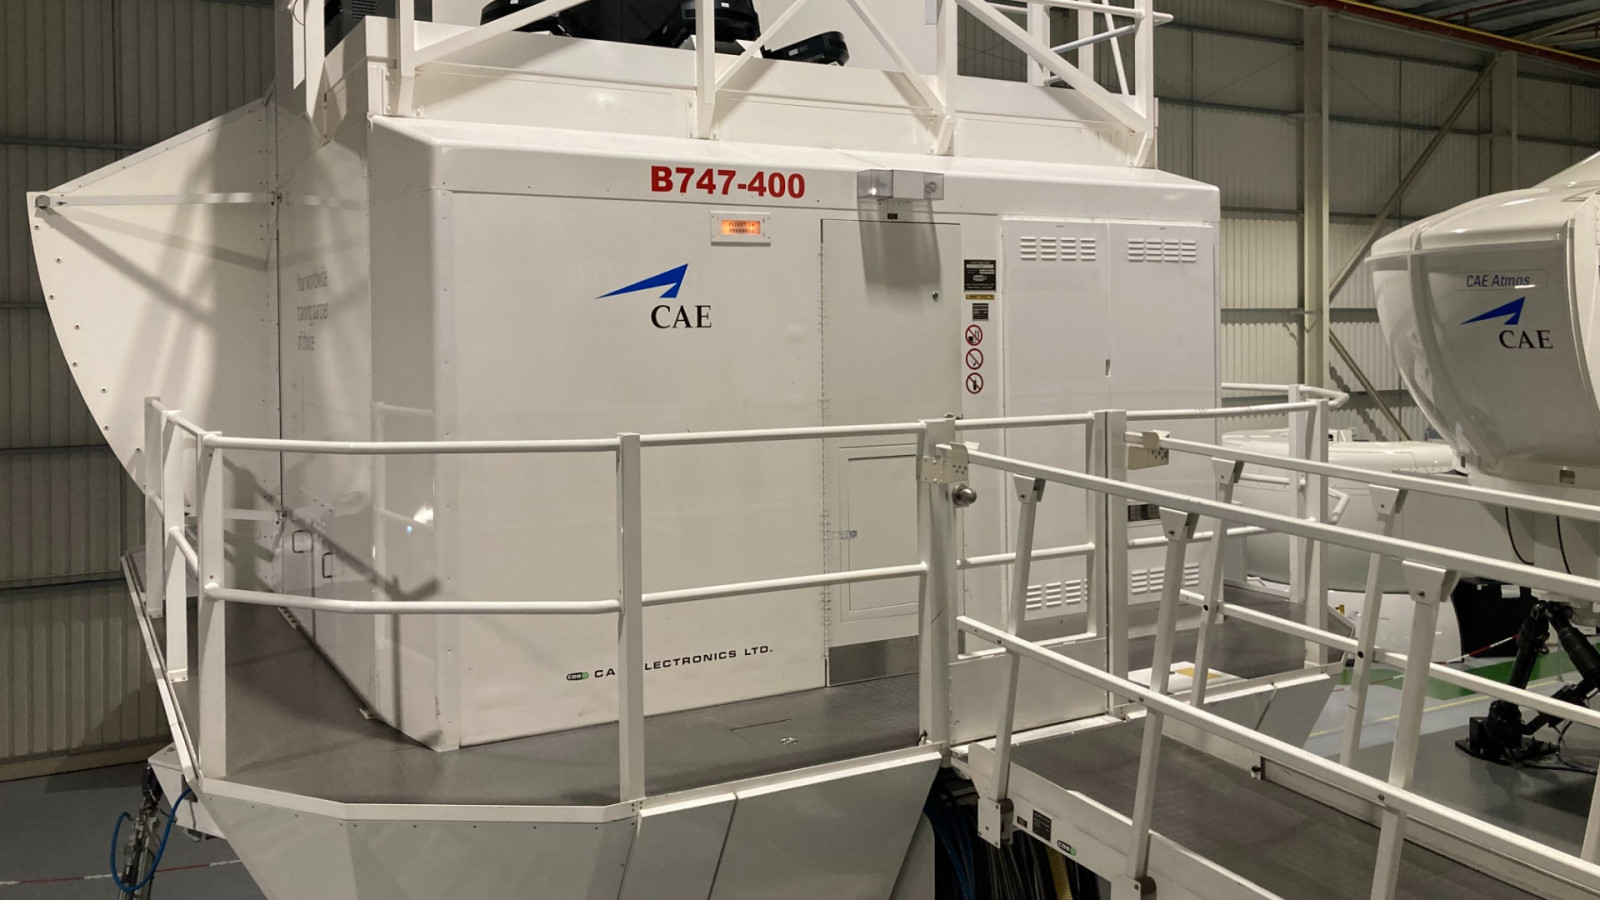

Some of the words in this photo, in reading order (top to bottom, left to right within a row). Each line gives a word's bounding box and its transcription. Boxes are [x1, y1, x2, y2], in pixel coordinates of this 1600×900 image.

[650, 165, 806, 199] B747-400
[1466, 274, 1489, 288] CAE
[1491, 274, 1530, 287] Atmos
[650, 304, 712, 329] CAE
[1499, 329, 1554, 349] CAE
[644, 649, 737, 671] LECTRONICS
[744, 645, 773, 656] LTD.
